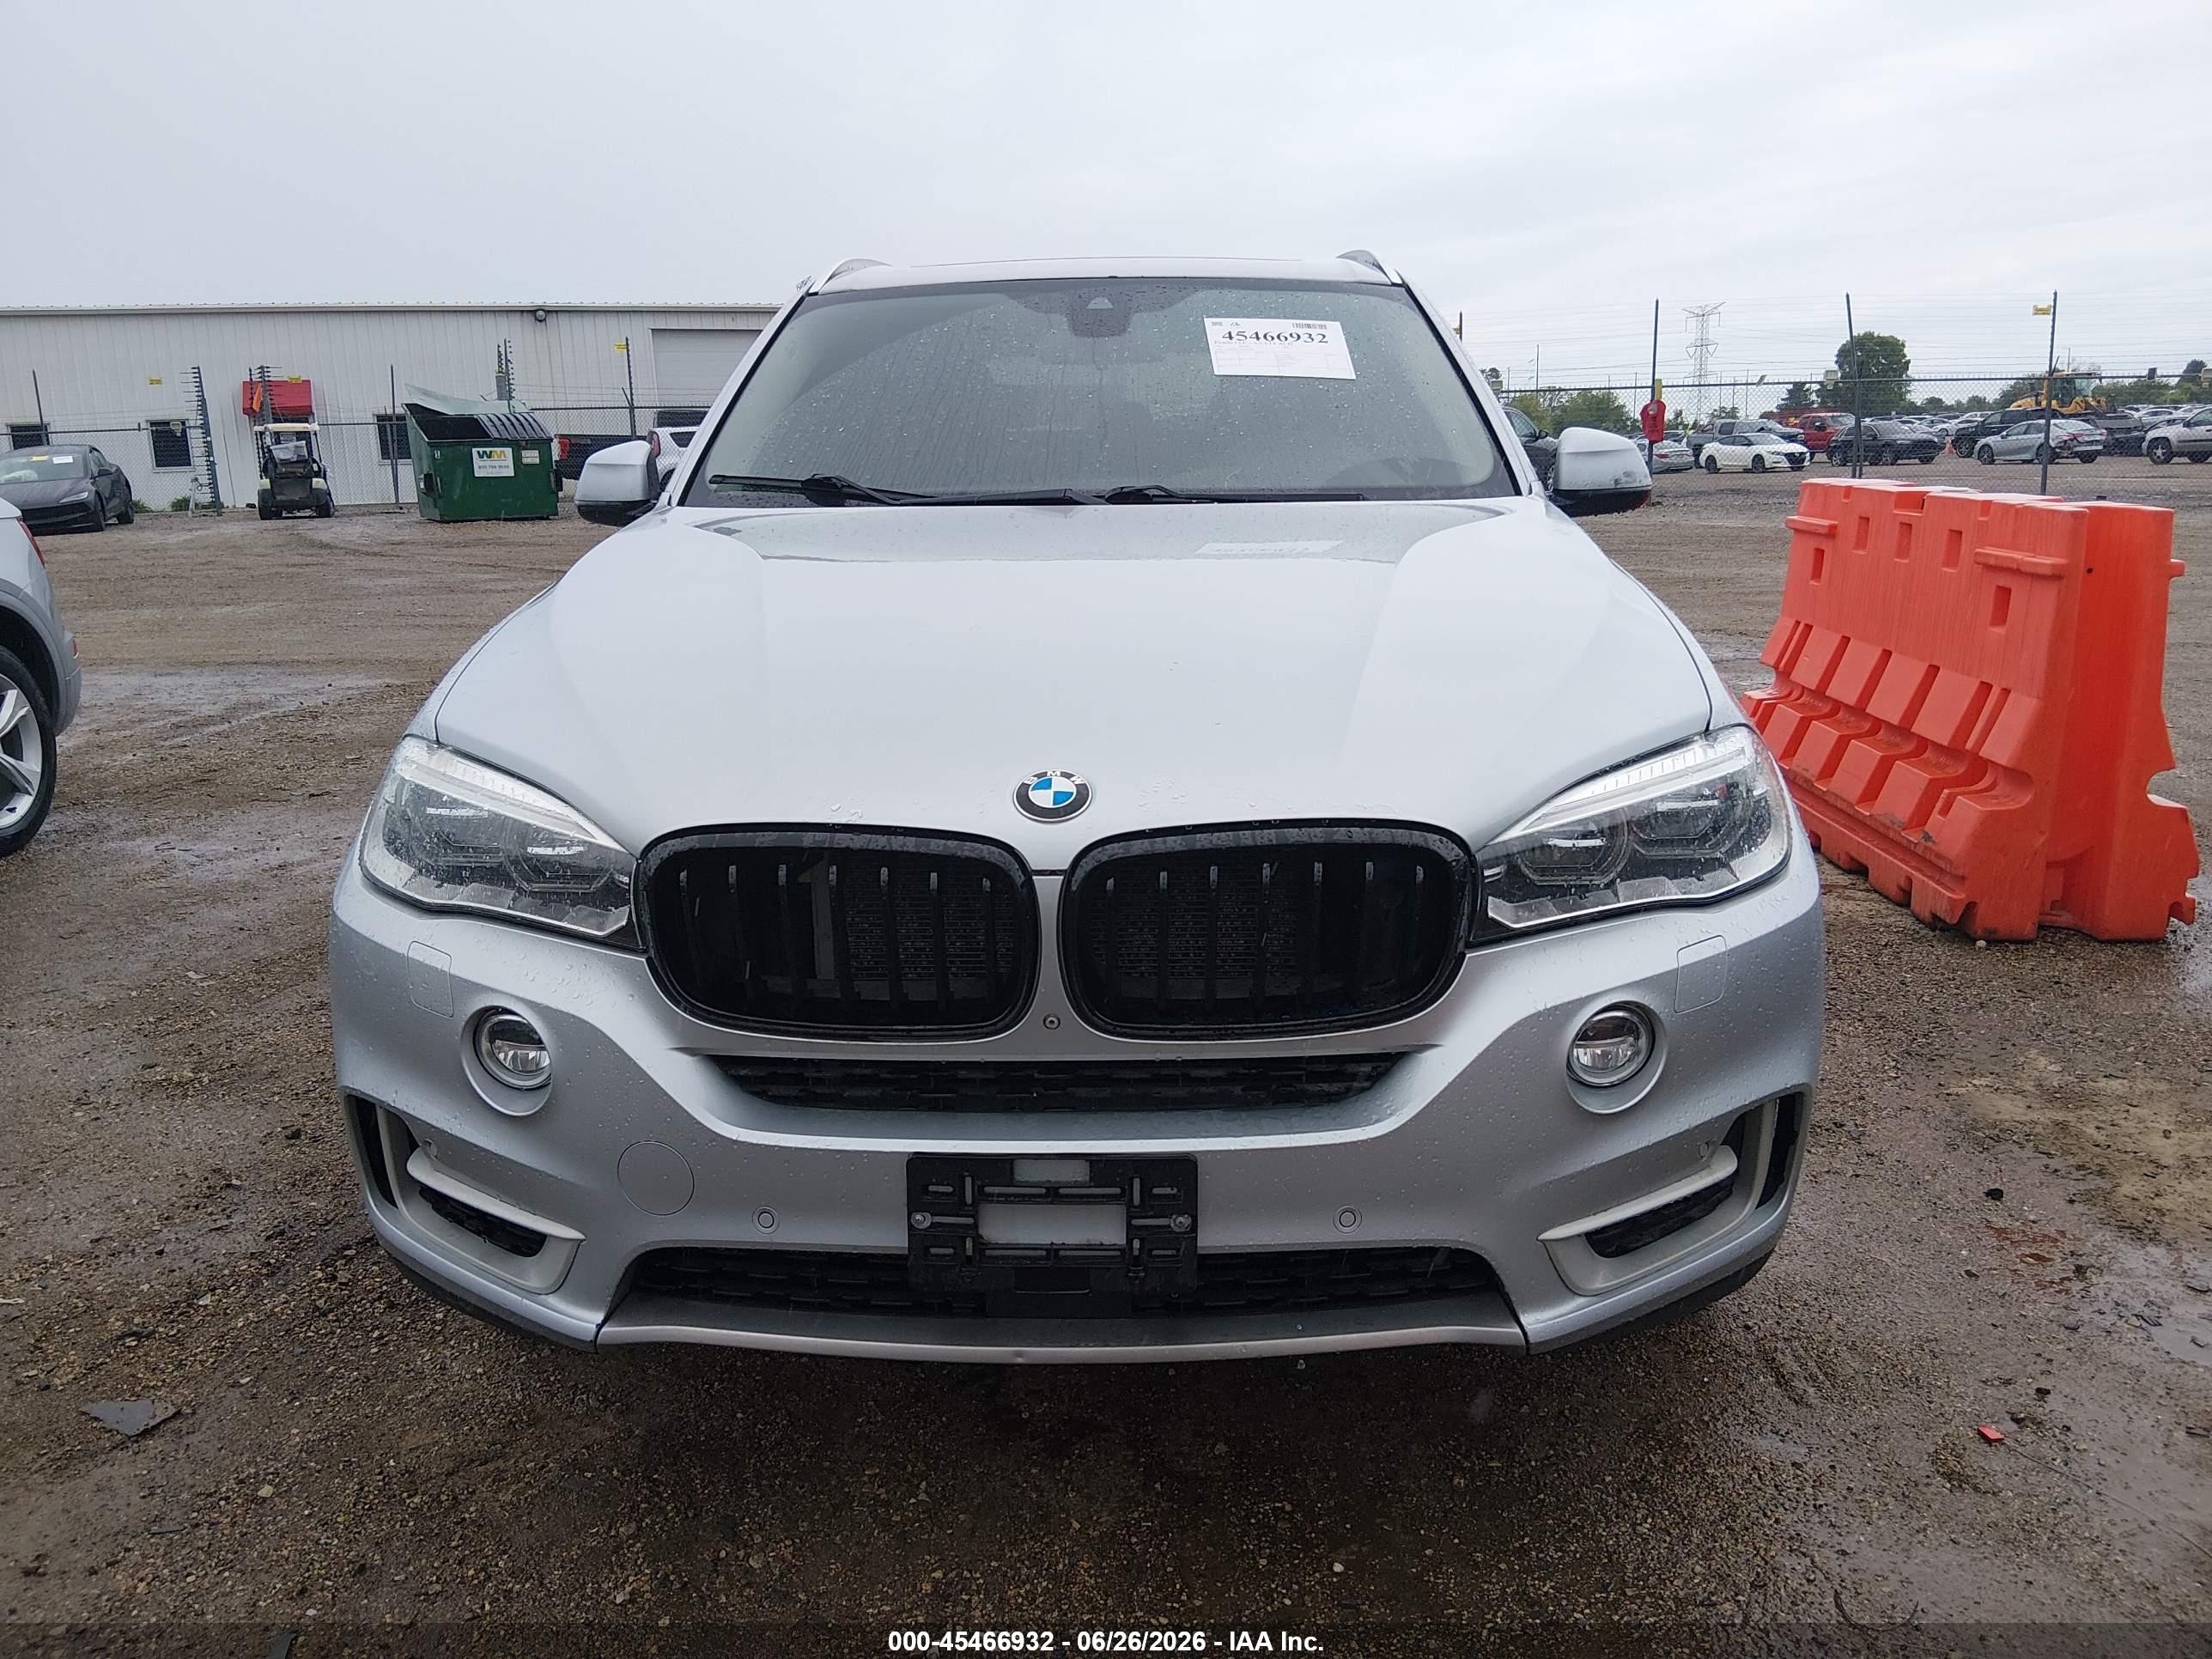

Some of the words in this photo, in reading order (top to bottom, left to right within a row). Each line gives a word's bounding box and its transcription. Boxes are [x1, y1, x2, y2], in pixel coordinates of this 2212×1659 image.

[1222, 330, 1329, 344] 45466932
[477, 450, 507, 459] WM
[1023, 769, 1085, 785] BMW
